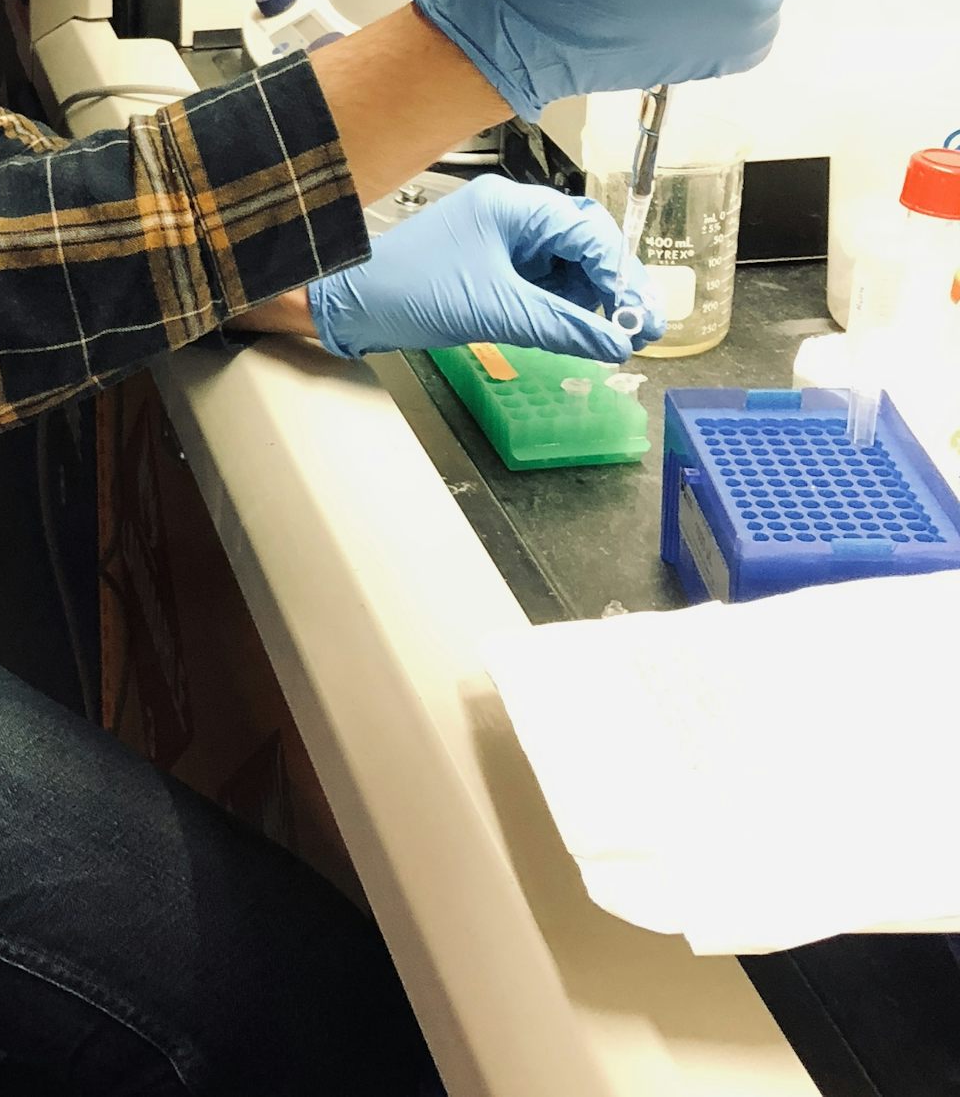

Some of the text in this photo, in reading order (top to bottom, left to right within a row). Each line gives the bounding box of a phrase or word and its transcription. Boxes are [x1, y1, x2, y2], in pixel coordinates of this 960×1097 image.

[645, 235, 695, 249] 400 mL
[713, 233, 724, 245] 50
[708, 255, 723, 269] 100
[706, 278, 721, 291] 150
[702, 300, 719, 314] 200
[701, 322, 718, 336] 250
